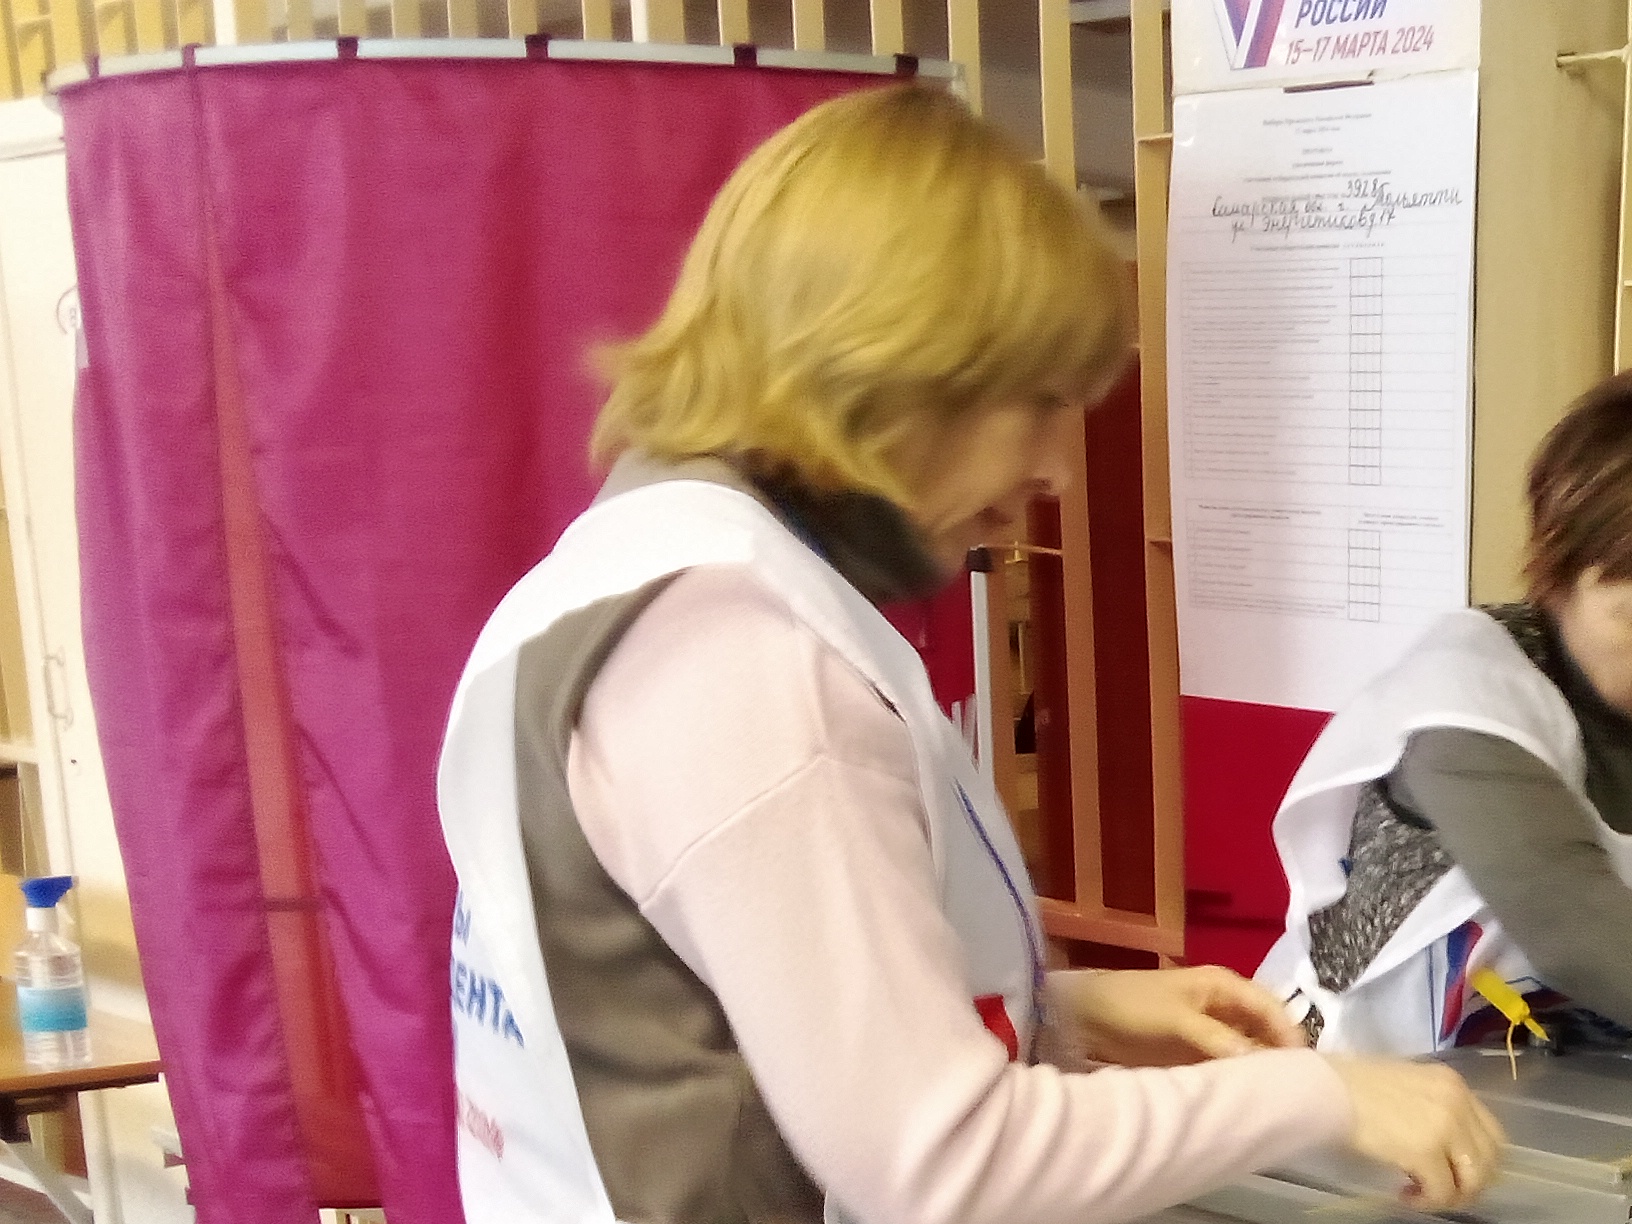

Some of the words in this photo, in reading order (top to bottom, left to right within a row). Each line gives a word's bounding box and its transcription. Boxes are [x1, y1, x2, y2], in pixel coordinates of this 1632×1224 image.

[1295, 0, 1388, 28] РОССИИ
[1331, 30, 1388, 60] МАРТА
[1391, 25, 1435, 54] 2024
